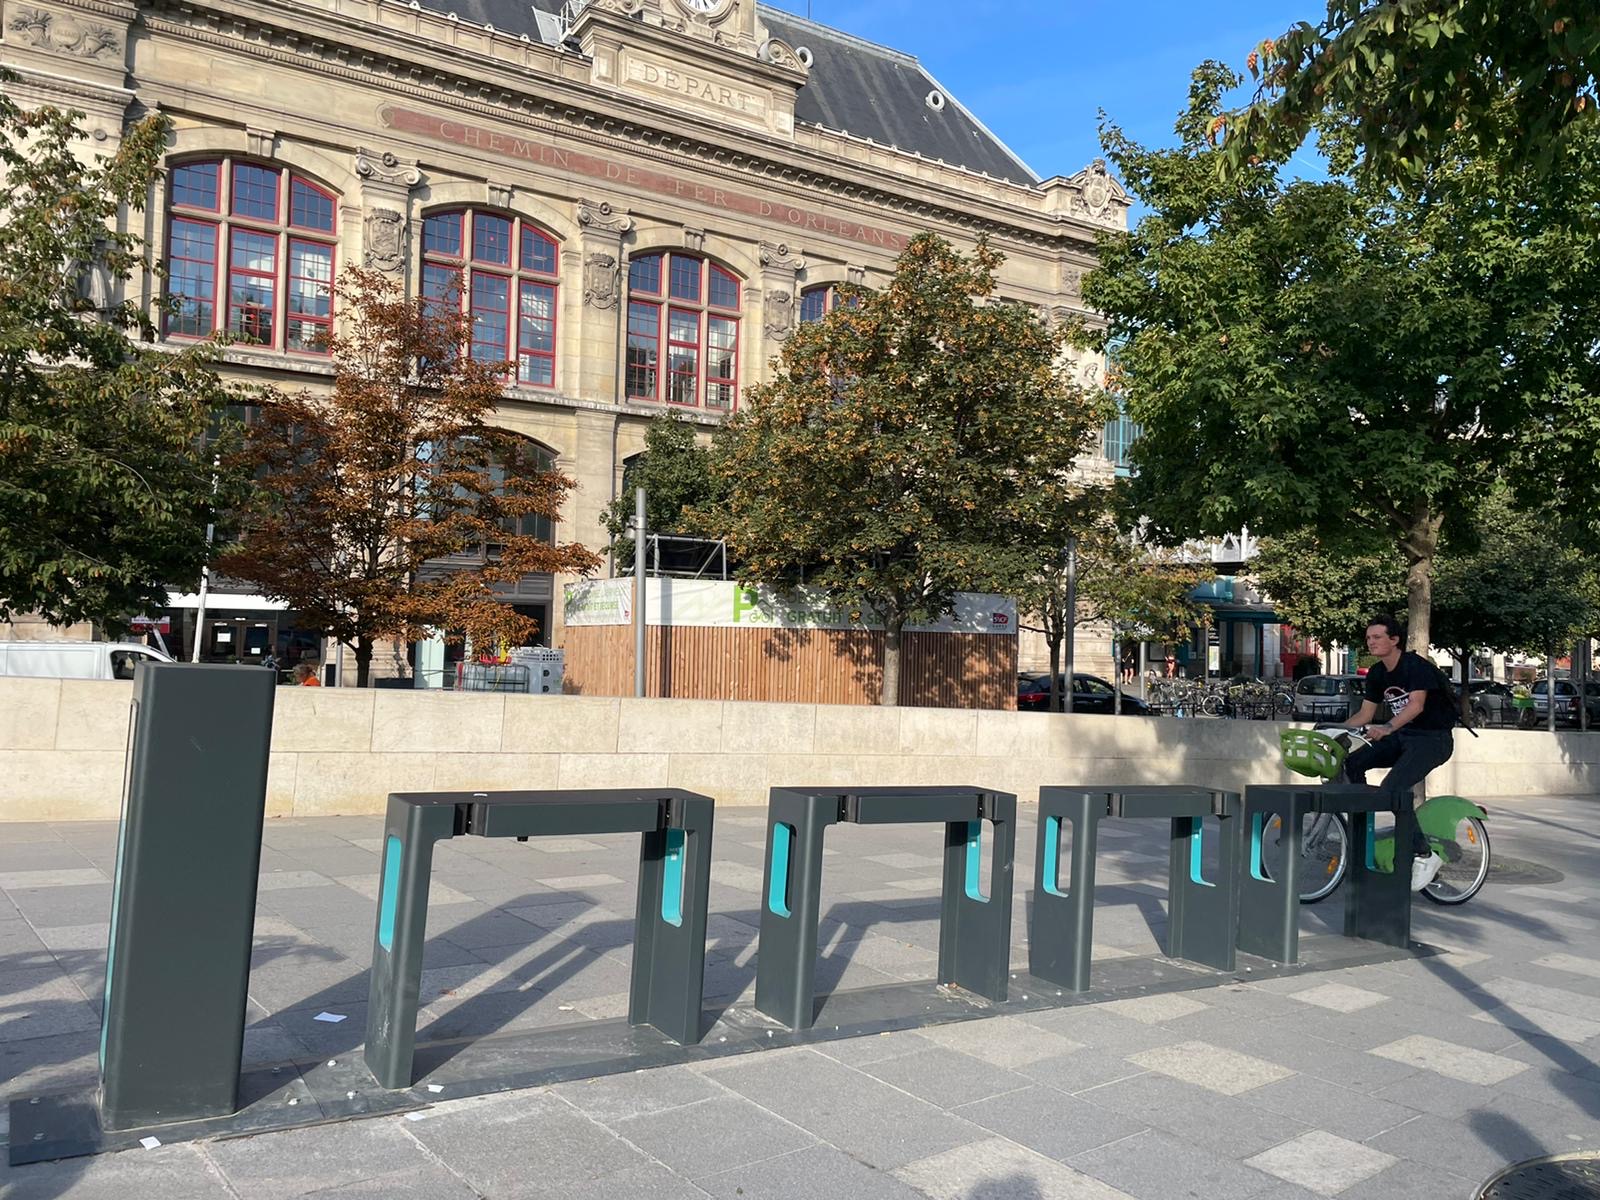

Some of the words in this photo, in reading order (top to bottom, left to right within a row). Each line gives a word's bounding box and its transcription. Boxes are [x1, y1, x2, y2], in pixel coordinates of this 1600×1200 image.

[440, 121, 570, 168] CHEMIN
[606, 163, 641, 185] DE
[675, 180, 728, 206] FER
[787, 610, 845, 624] GRATUIT
